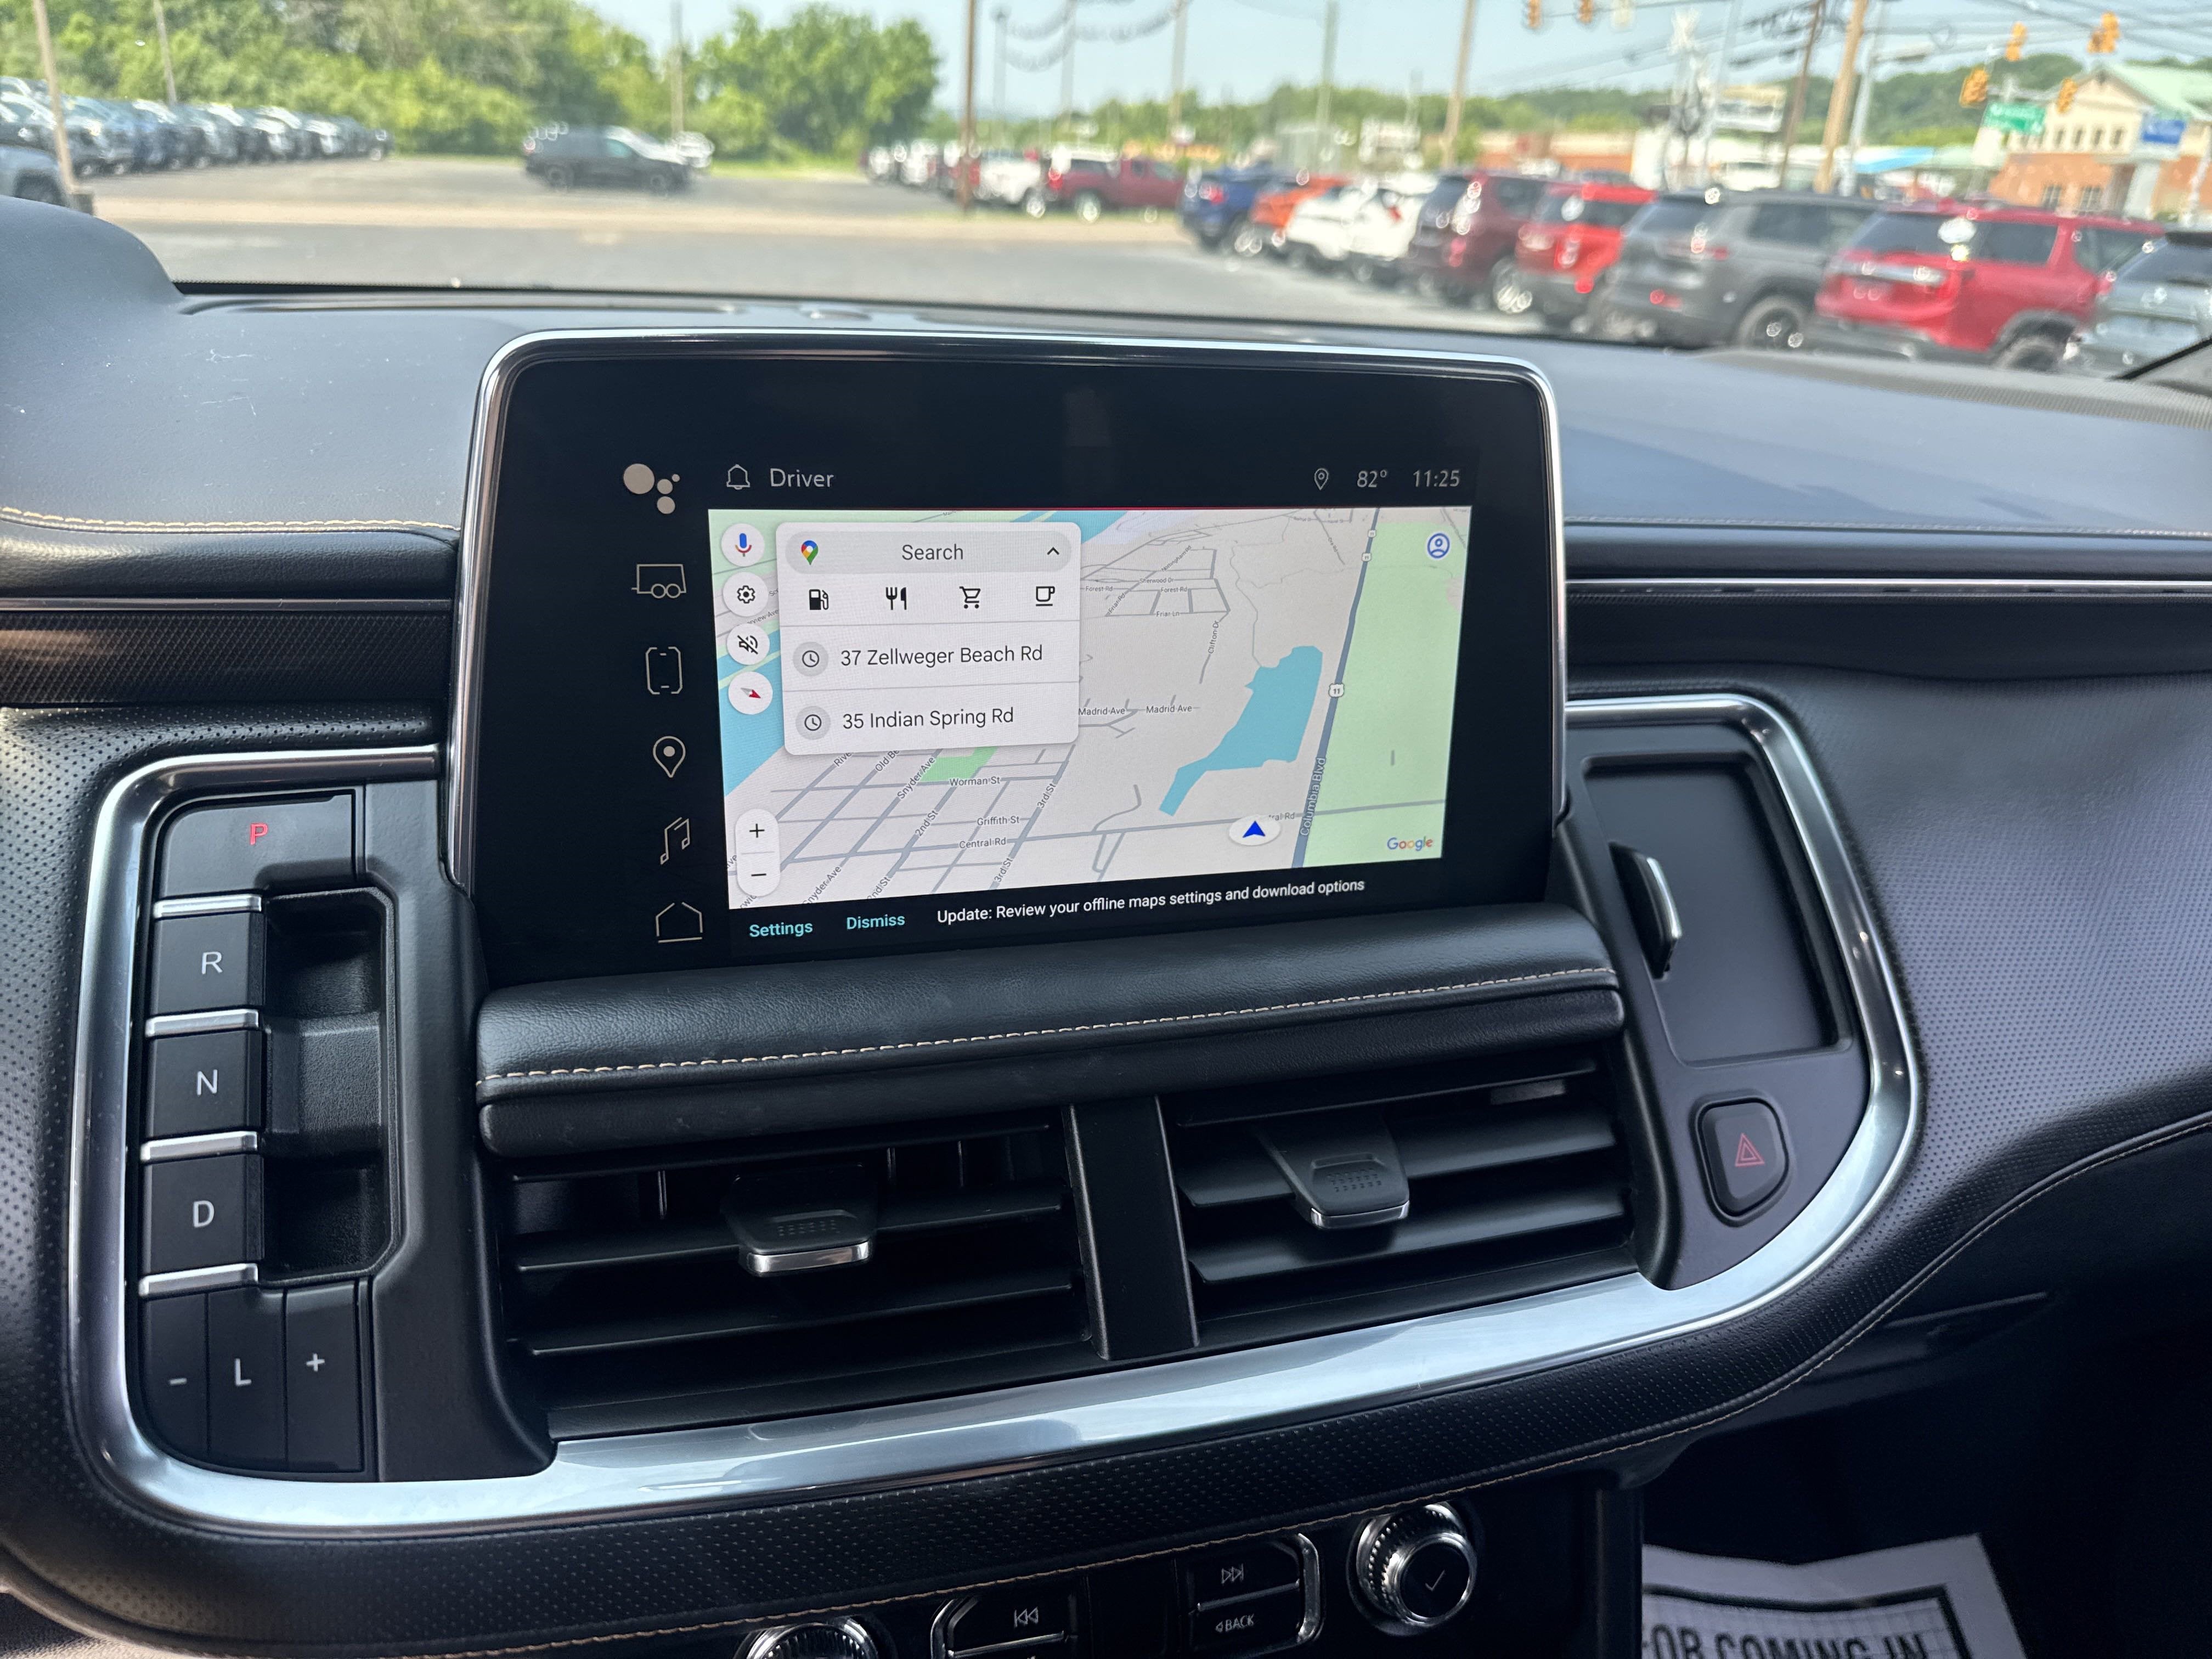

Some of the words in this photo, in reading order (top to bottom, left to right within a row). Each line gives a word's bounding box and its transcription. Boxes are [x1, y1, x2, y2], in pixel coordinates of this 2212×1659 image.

[770, 468, 834, 487] Driver
[1357, 470, 1387, 488] 82°
[1413, 470, 1460, 487] 11:25
[902, 544, 963, 560] Search
[1161, 550, 1186, 572] Nottingham
[1108, 599, 1120, 613] Friar
[1118, 592, 1125, 601] Rd
[1212, 620, 1220, 629] Dr
[1207, 629, 1219, 654] Clifton
[841, 651, 861, 666] 37
[867, 648, 955, 668] Zellweger
[961, 645, 1014, 663] Beach
[1021, 645, 1042, 661] Rd
[843, 713, 864, 729] 35
[870, 710, 924, 728] Indian
[930, 708, 986, 730] Spring
[992, 707, 1013, 723] Rd
[1110, 707, 1125, 715] Ave
[1146, 705, 1175, 714] Madrid
[875, 757, 890, 772] Old
[897, 772, 921, 799] Snyder
[921, 757, 935, 773] Ave
[950, 777, 988, 786] Worman
[991, 776, 1001, 785] St
[1037, 793, 1050, 808] 3rd
[1046, 783, 1056, 794] St
[1300, 785, 1320, 836] Columbia
[1312, 758, 1326, 781] Blvd
[915, 820, 931, 837] 2nd
[928, 810, 938, 821] St
[977, 816, 1007, 826] Griffith
[1010, 815, 1020, 823] St
[250, 823, 268, 845] P
[959, 839, 992, 849] Central
[995, 837, 1007, 845] Rd
[1387, 836, 1434, 851] Google
[827, 866, 842, 882] Ave
[994, 867, 1007, 883] 3rd
[1003, 857, 1013, 867] St
[879, 877, 891, 887] St
[749, 922, 812, 938] Settings
[847, 913, 905, 930] Dismiss
[937, 908, 992, 926] Update:
[996, 904, 1046, 918] Review
[1049, 902, 1080, 917] your
[1083, 897, 1125, 912] offline
[1128, 896, 1166, 910] maps
[1169, 890, 1222, 905] settings
[1225, 886, 1249, 901] and
[1252, 881, 1315, 899] download
[1317, 879, 1365, 896] options
[201, 951, 223, 975] R
[196, 1069, 218, 1096] N
[193, 1200, 215, 1228] D
[234, 1358, 252, 1386] L
[1225, 1613, 1255, 1633] BACK
[1643, 1624, 1704, 1659] OR
